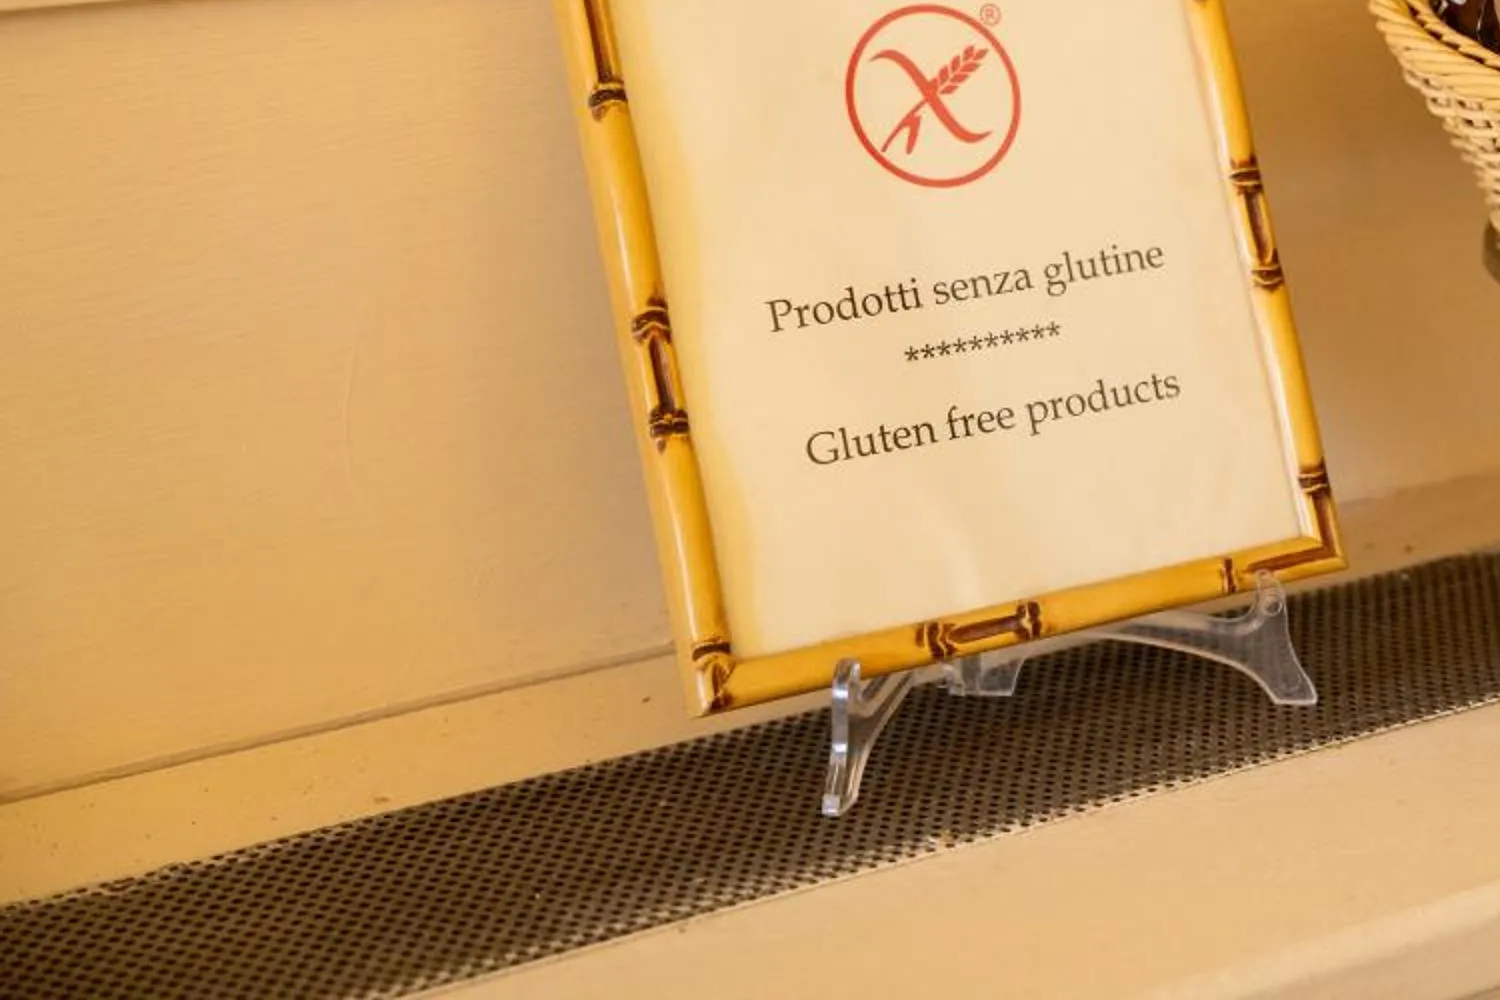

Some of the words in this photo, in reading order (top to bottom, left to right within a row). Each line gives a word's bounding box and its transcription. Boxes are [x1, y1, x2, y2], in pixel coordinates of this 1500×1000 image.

[766, 278, 922, 332] Prodotti
[932, 264, 1034, 307] senza
[1044, 243, 1166, 297] glutine
[805, 416, 938, 466] Gluten
[946, 405, 1016, 442] free
[1025, 372, 1181, 436] products
